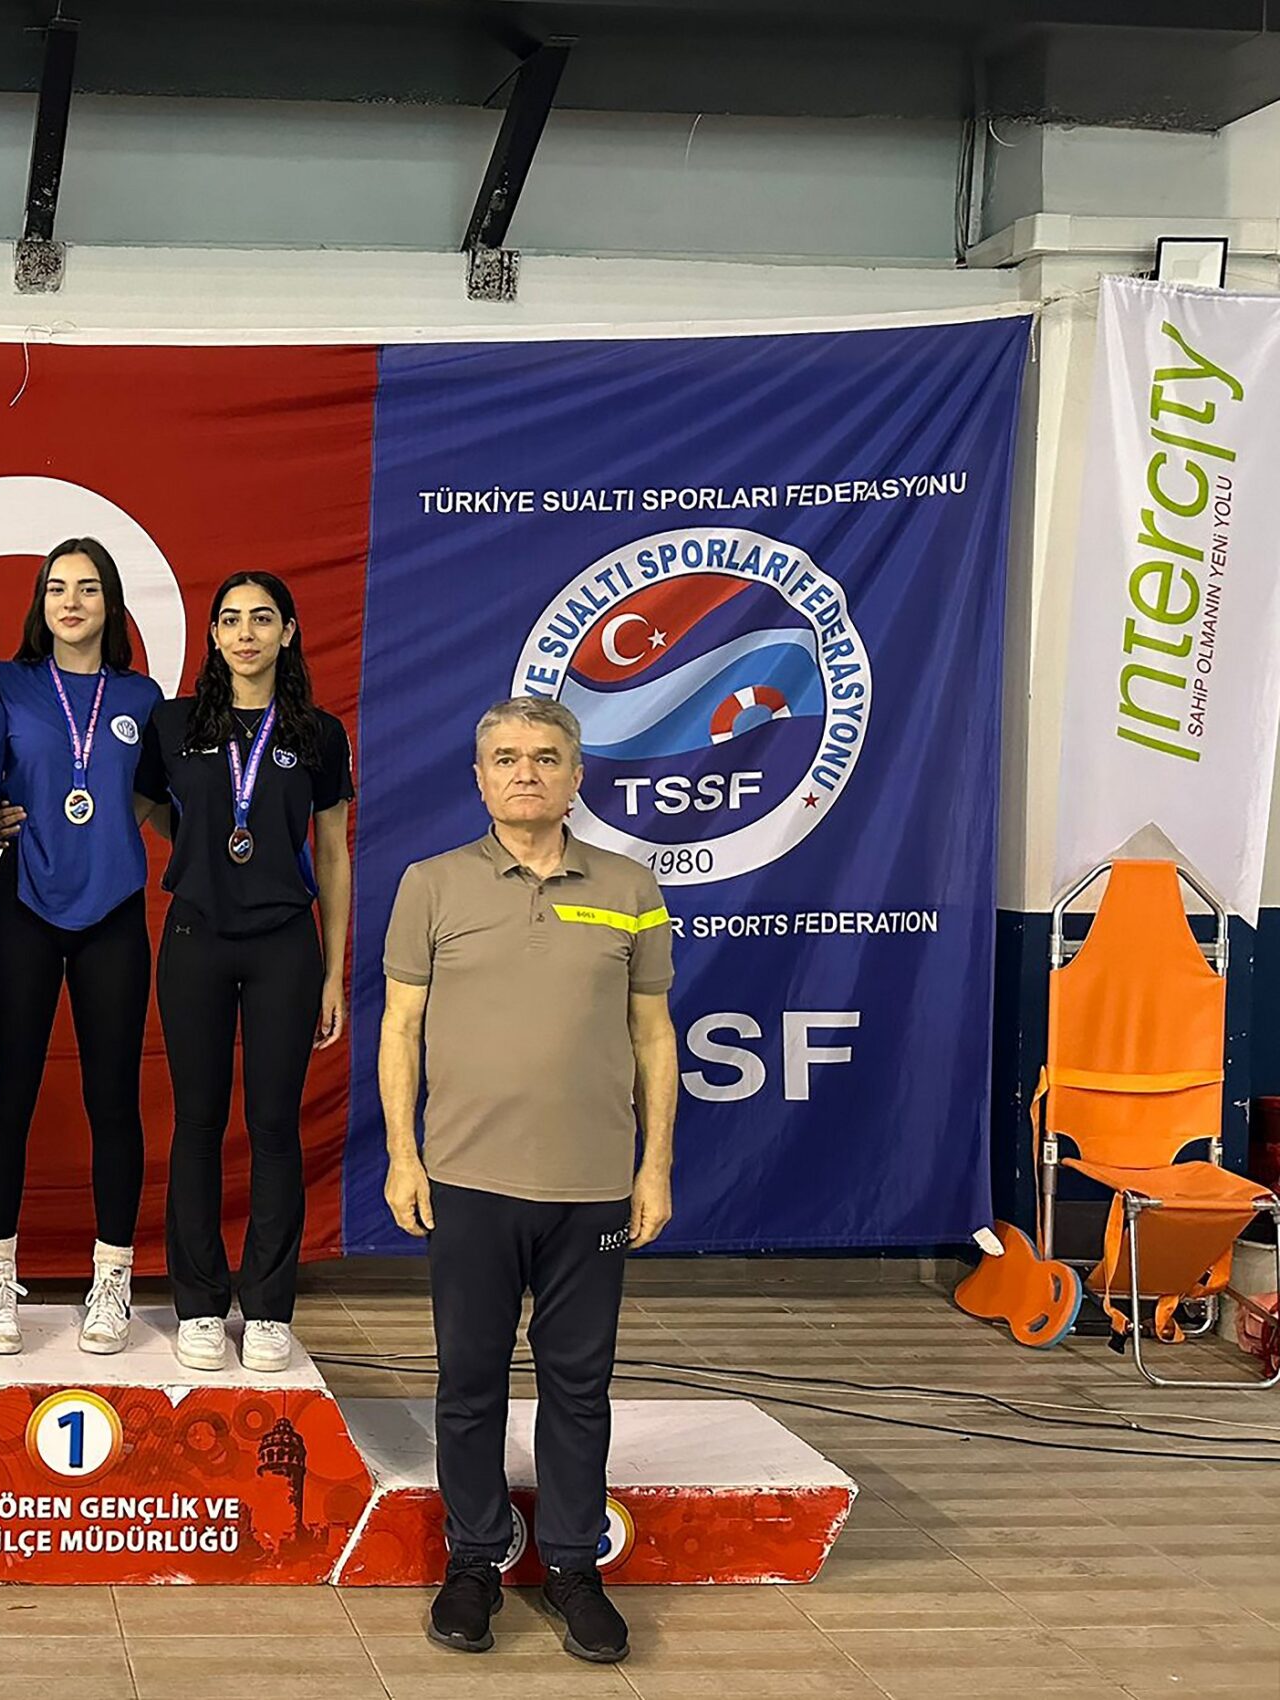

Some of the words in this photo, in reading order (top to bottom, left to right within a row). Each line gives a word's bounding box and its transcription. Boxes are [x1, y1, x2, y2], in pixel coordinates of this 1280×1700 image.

[419, 486, 535, 513] TÜRKİYE
[542, 490, 634, 512] SUALTI
[642, 487, 778, 511] SPORLARI
[785, 472, 967, 507] FEDERASYONU
[1196, 584, 1222, 674] OLMANIN
[1214, 475, 1233, 528] YOLU
[537, 562, 633, 659] SUALTI
[636, 539, 800, 587] SPORLARI
[788, 570, 865, 791] FEDERASYONU
[614, 771, 763, 815] TSSF
[647, 848, 714, 875] 1980
[692, 914, 788, 938] SPORTS
[793, 911, 938, 934] FEDERATION
[681, 1011, 861, 1102] SF
[57, 1410, 86, 1469] 1
[79, 1492, 199, 1524] GENÇLİK
[205, 1497, 240, 1519] VE
[59, 1525, 240, 1552] MÜDÜRLÜĞÜ
